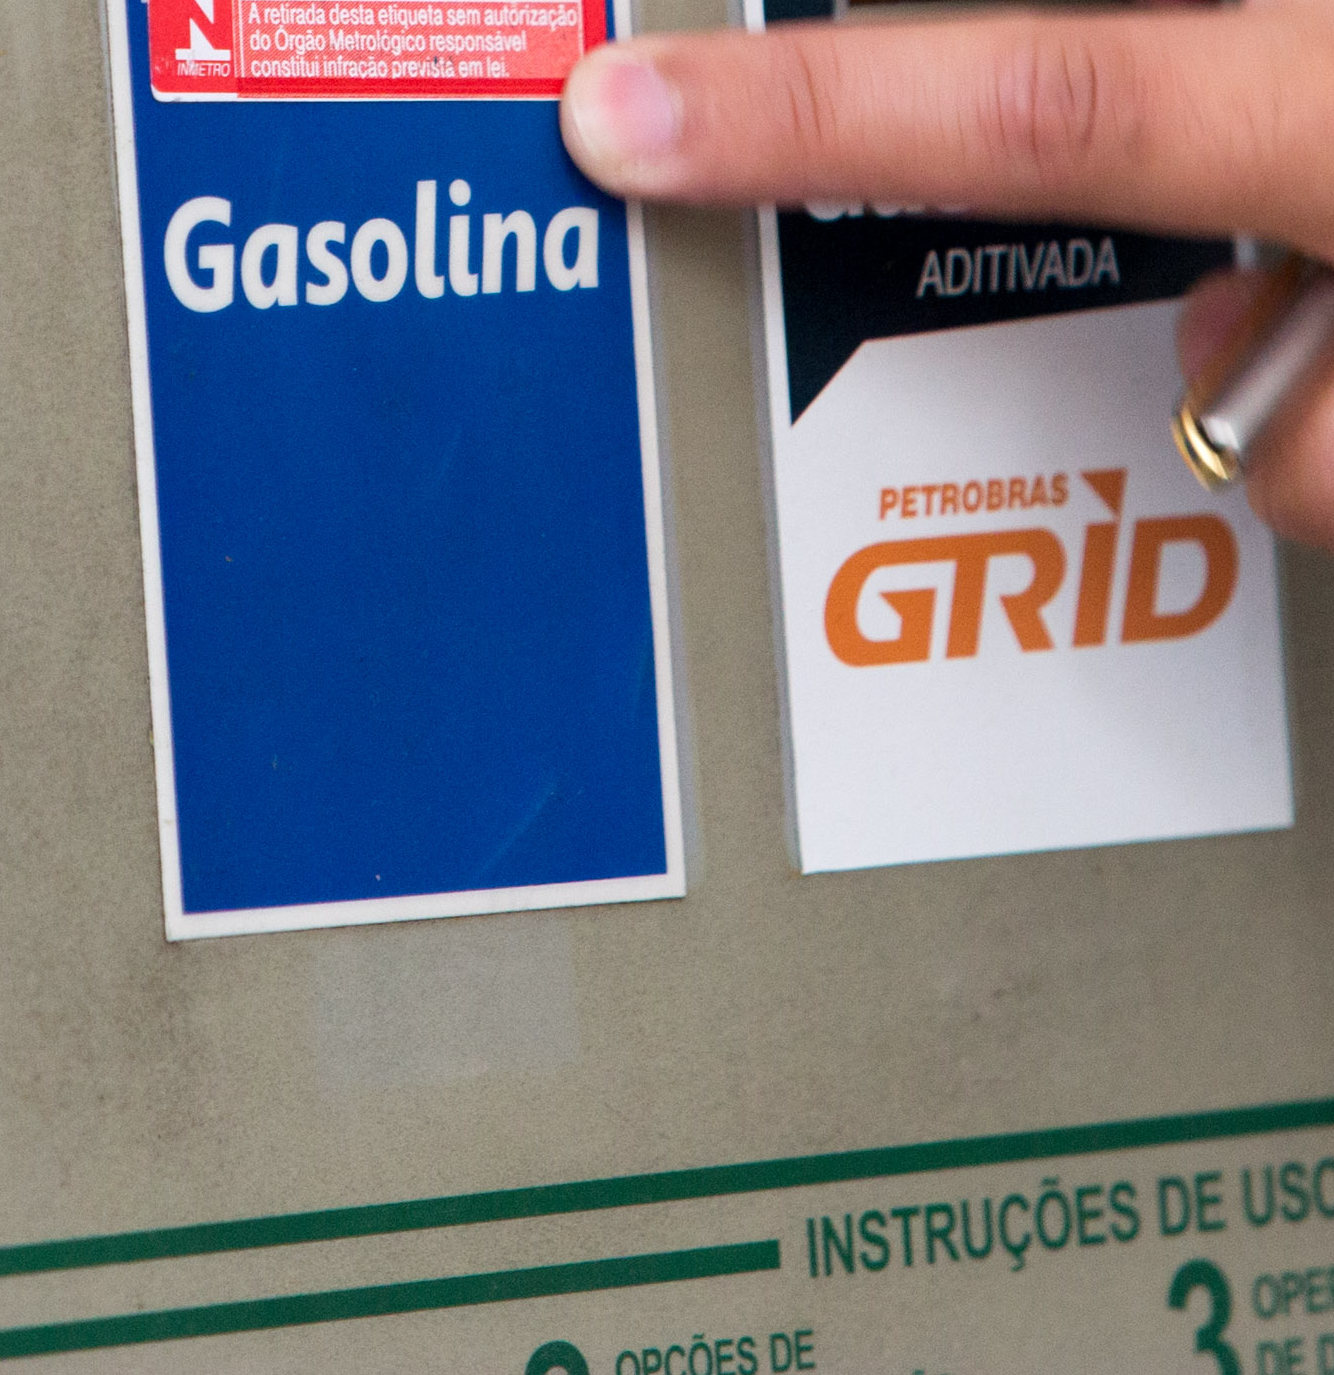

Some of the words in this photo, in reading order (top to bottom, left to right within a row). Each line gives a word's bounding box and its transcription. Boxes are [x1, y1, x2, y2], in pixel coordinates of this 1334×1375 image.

[248, 1, 261, 24] A
[264, 2, 326, 25] retirada
[329, 3, 375, 25] desta
[378, 4, 444, 30] etiqueta
[447, 7, 481, 26] sem
[484, 3, 577, 32] autorização
[249, 29, 271, 51] do
[274, 25, 326, 55] Órgão
[328, 28, 426, 56] Metrológico
[429, 29, 527, 55] responsável
[250, 55, 323, 78] constitui
[323, 55, 389, 79] infração
[391, 56, 455, 79] prevista
[458, 59, 483, 78] em
[486, 56, 510, 78] lei.
[163, 178, 600, 314] Gasolina
[915, 236, 1121, 299] ADITIVADA
[878, 471, 1070, 521] PETROBRAS
[804, 1178, 1143, 1279] INSTRUÇÕES
[1157, 1169, 1226, 1238] DE
[769, 1329, 816, 1371] DE
[1255, 1336, 1305, 1375] DE
